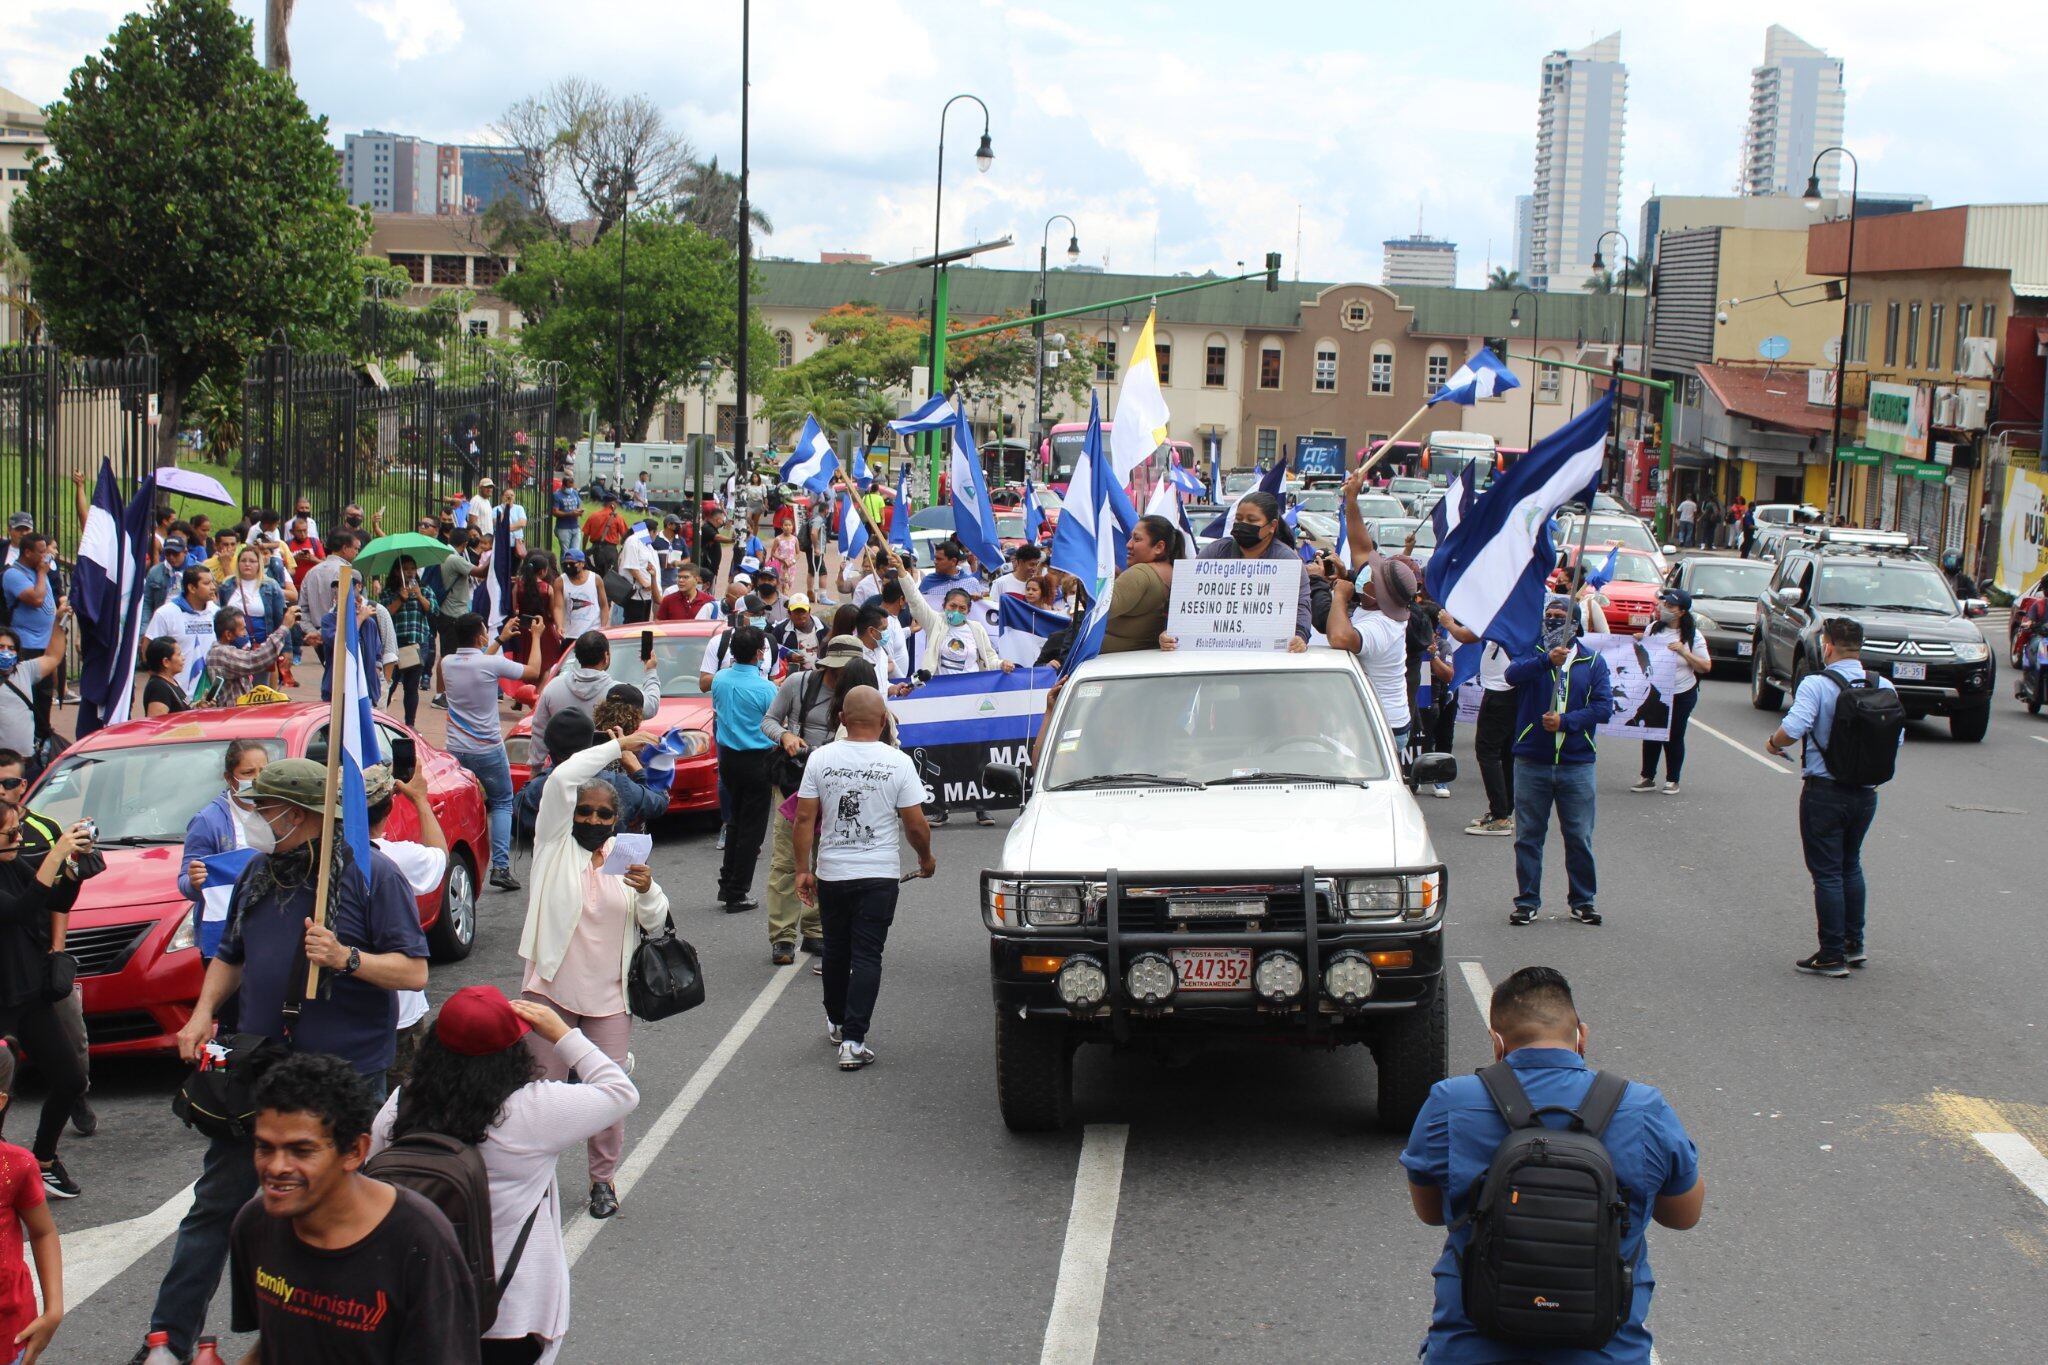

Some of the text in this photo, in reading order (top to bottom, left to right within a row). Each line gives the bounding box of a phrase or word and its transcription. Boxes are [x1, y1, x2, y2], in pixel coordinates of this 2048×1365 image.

[1197, 582, 1271, 596] PORQUE ES UN
[1180, 601, 1222, 614] ASESINO
[1226, 601, 1239, 614] DE
[1278, 602, 1285, 615] Y
[247, 689, 274, 702] Taxi
[1184, 959, 1248, 980] 247352
